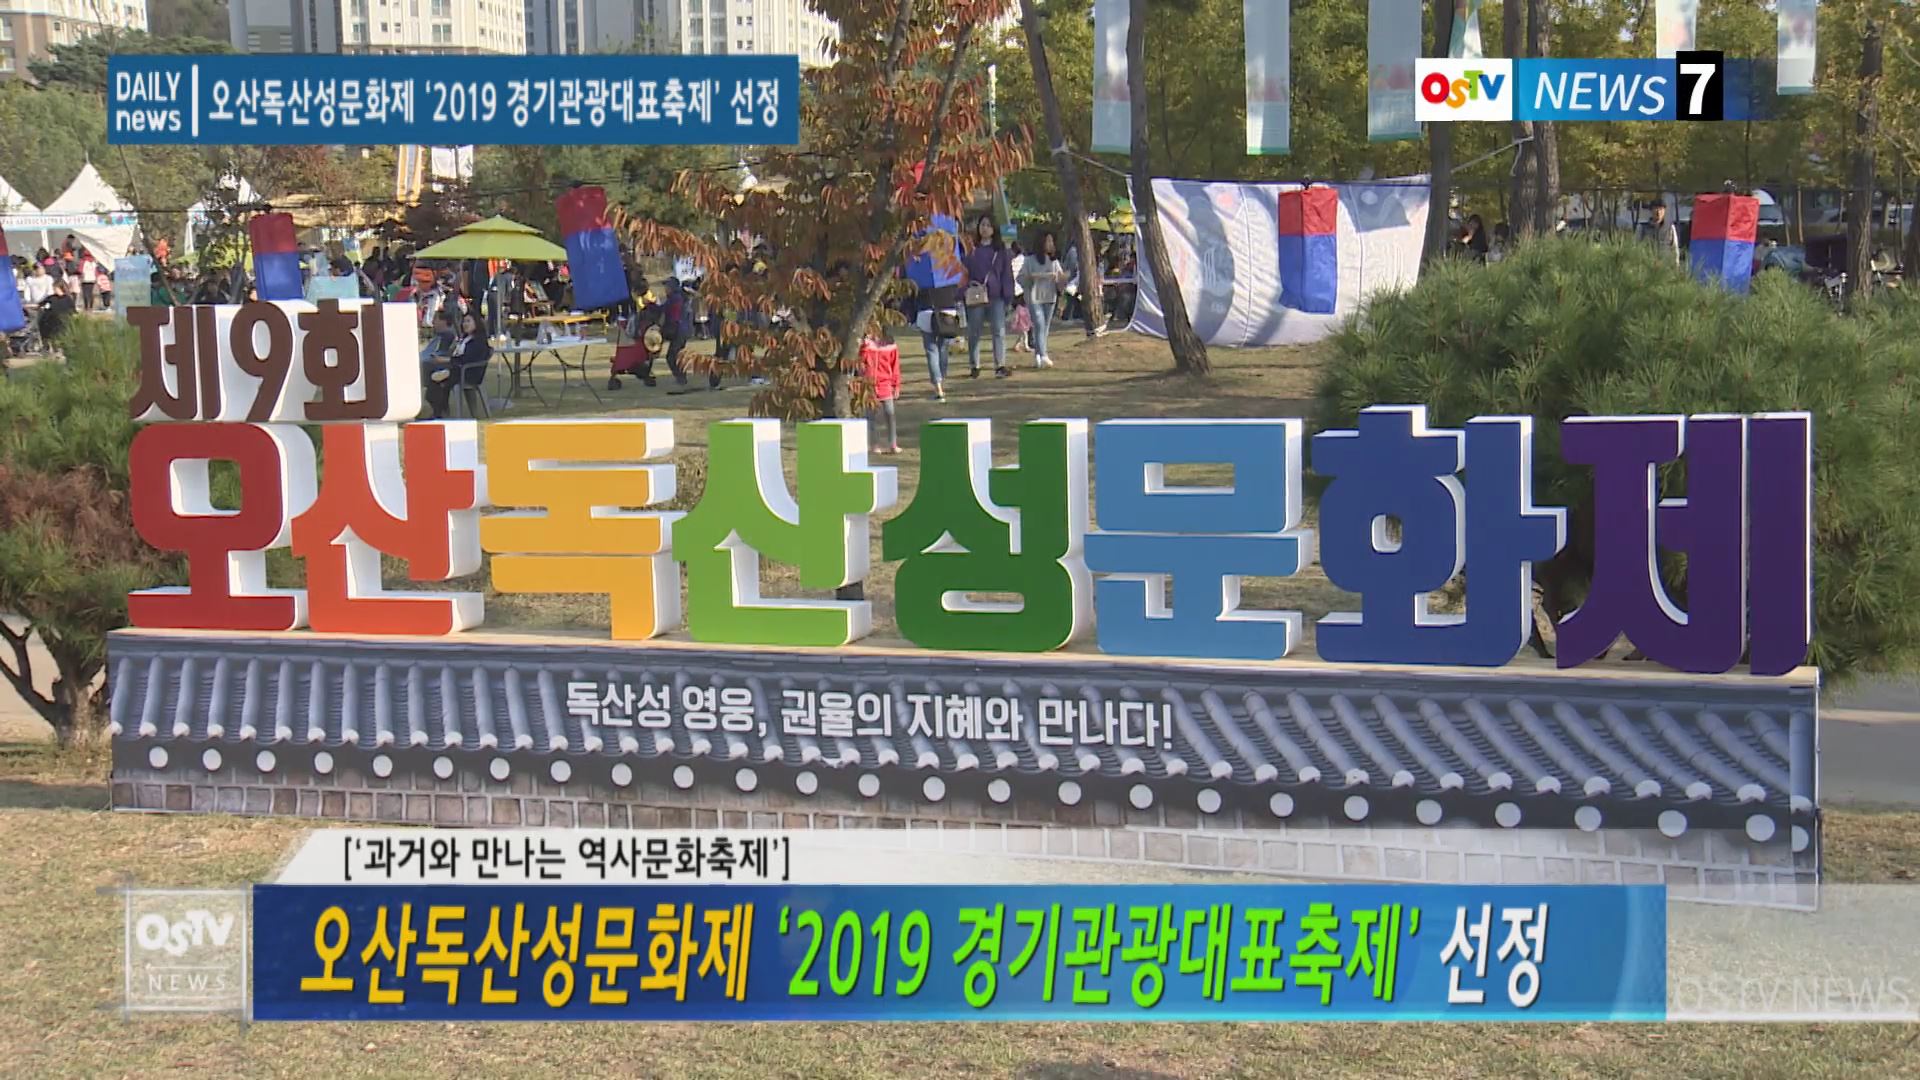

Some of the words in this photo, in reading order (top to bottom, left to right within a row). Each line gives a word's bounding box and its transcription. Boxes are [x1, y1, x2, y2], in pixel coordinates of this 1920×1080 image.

[126, 298, 389, 421] 제9회
[127, 404, 1812, 676] 오산독산성문화제
[565, 680, 671, 729] 독산성
[681, 683, 768, 738] 영웅,
[781, 688, 893, 739] 권율의
[906, 691, 1024, 743] 지혜와
[1038, 697, 1174, 752] 만나다!
